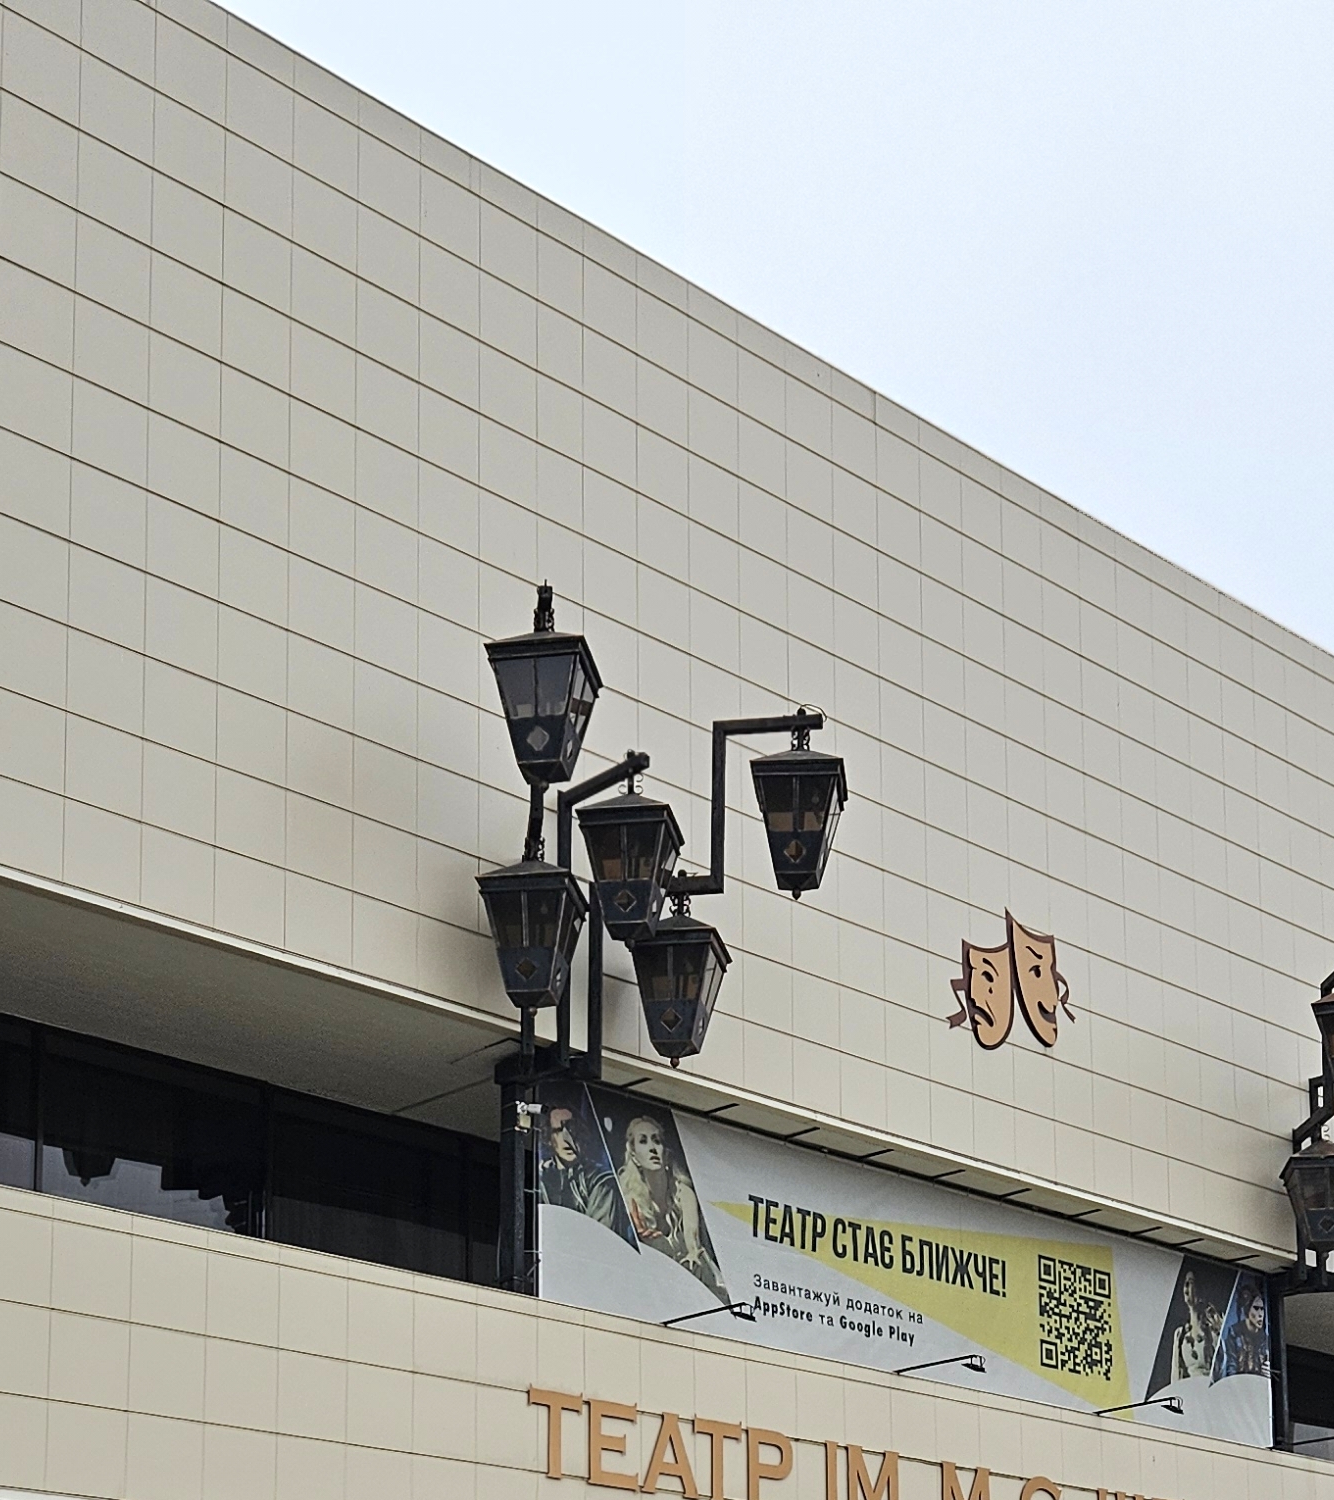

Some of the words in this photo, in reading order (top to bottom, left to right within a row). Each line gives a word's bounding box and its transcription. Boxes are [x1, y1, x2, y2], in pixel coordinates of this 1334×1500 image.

[748, 1194, 826, 1253] ТЕАТР
[832, 1217, 894, 1270] СТАЄ
[901, 1234, 1007, 1298] БЛИЖЧЕ!
[753, 1273, 840, 1307] Завантажуй
[846, 1296, 903, 1320] додаток
[908, 1311, 923, 1325] на
[753, 1296, 813, 1323] AppStore
[819, 1313, 834, 1327] та
[839, 1315, 883, 1338] Google
[888, 1325, 915, 1347] Play
